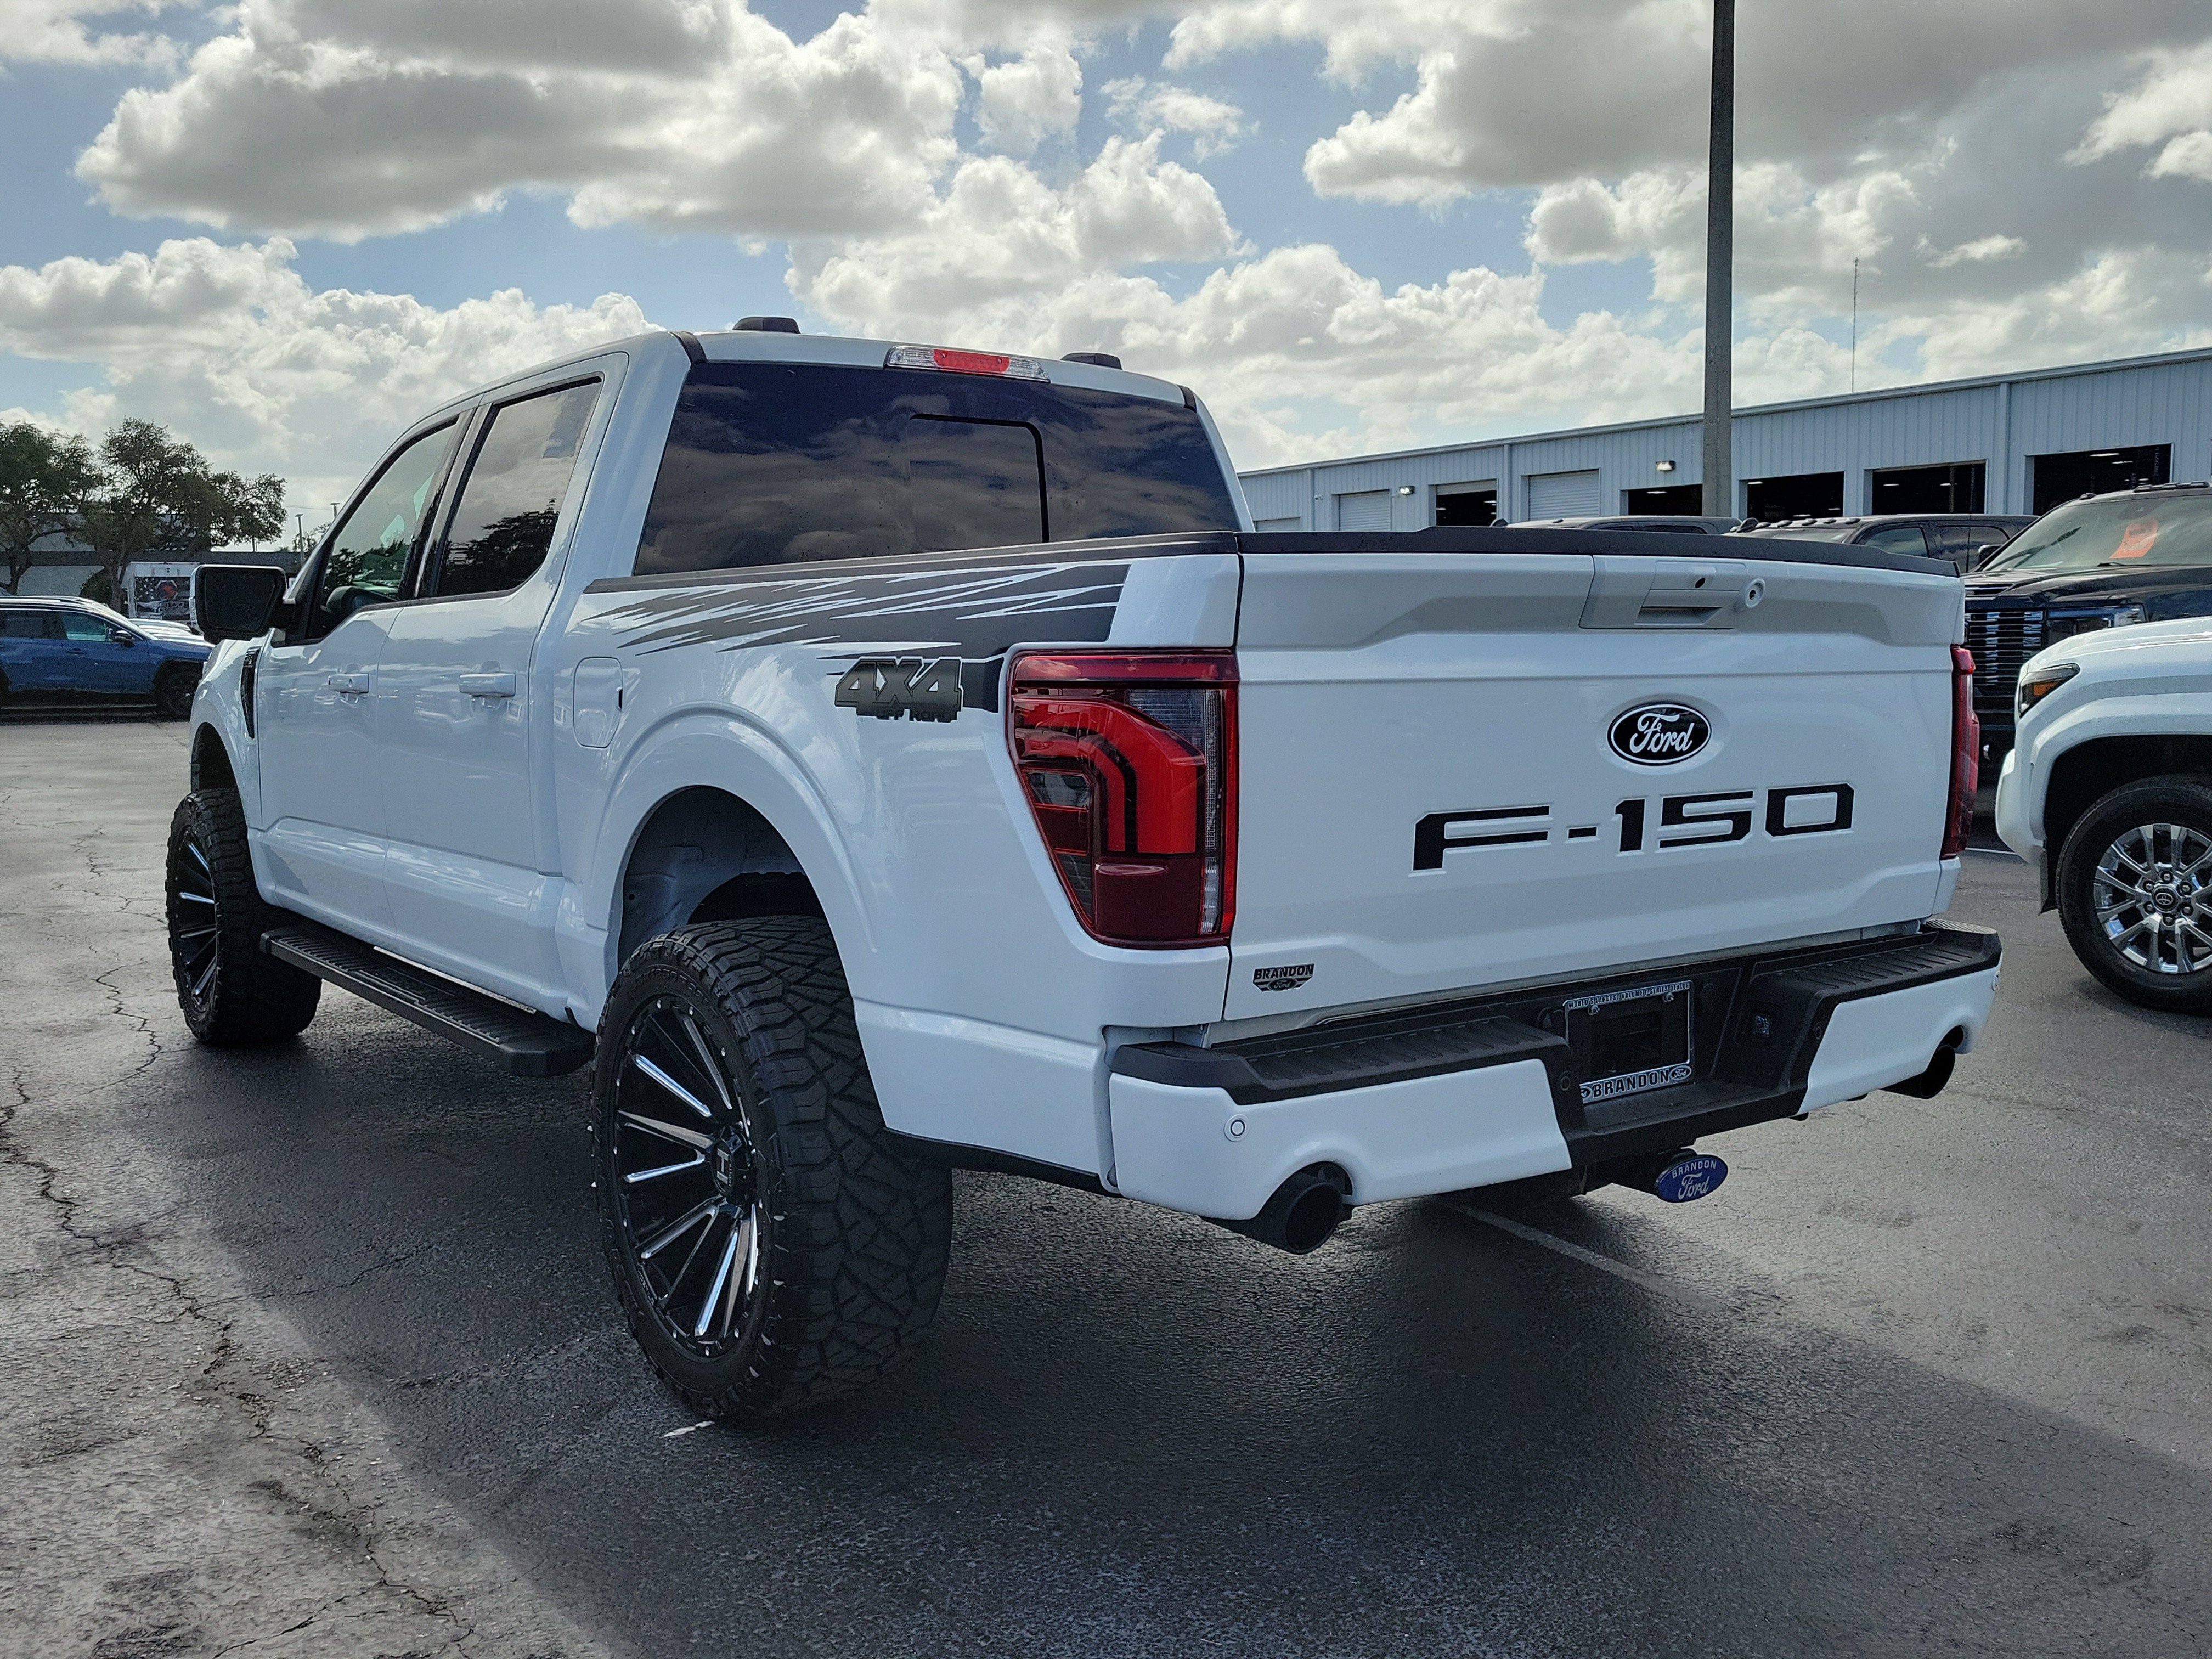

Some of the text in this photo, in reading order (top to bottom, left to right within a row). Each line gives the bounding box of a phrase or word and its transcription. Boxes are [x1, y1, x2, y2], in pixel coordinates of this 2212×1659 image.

[835, 658, 962, 710] 4X4
[1629, 713, 1695, 753] Ford
[1412, 782, 1855, 872] F-150
[1254, 965, 1313, 979] BRANDON
[1621, 990, 1643, 998] VOLUME
[1592, 1069, 1670, 1098] BRANDON
[1672, 1160, 1717, 1178] BRANDON
[1678, 1172, 1711, 1200] Ford
